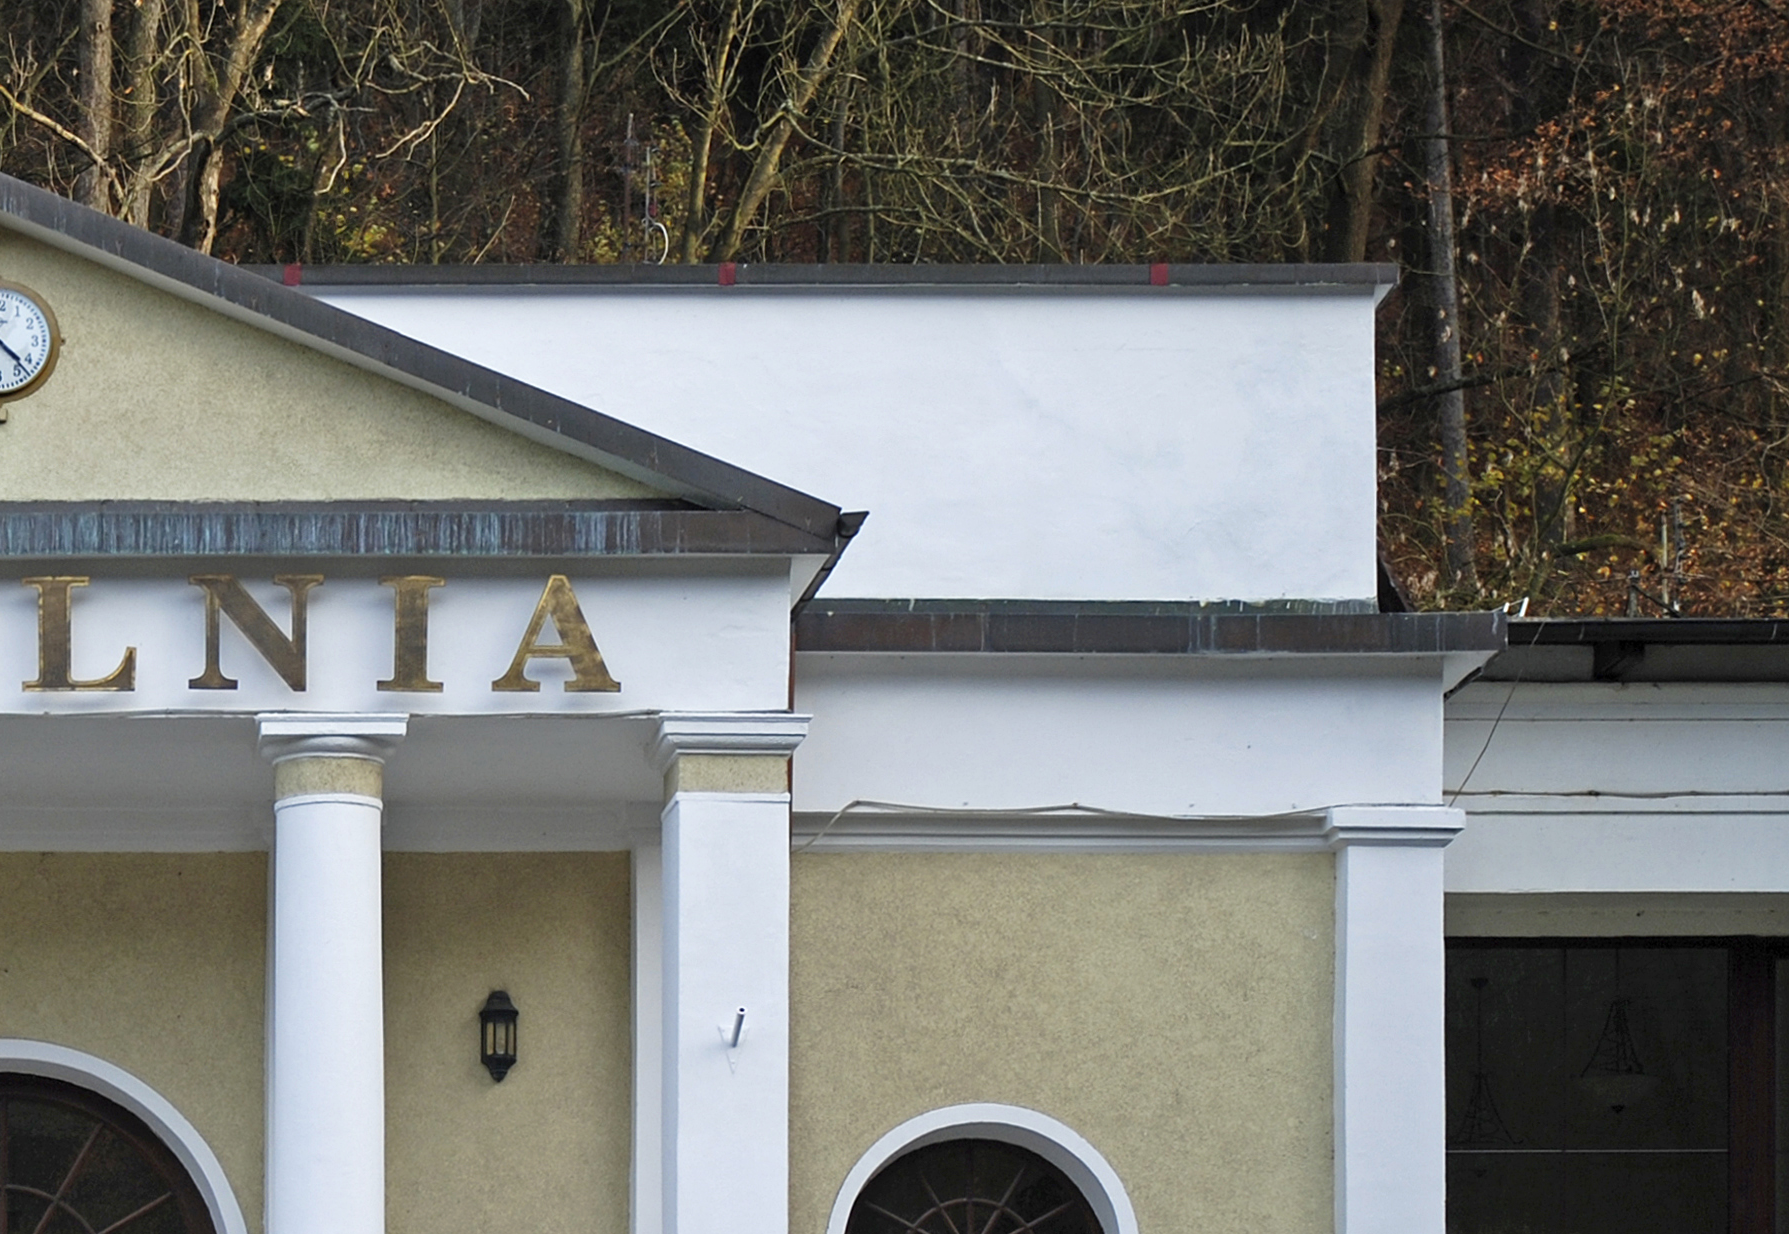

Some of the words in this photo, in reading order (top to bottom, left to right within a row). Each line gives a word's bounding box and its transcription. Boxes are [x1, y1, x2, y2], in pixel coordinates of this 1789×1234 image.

[14, 306, 20, 317] 1
[25, 318, 34, 330] 2
[31, 335, 39, 347] 3
[24, 353, 33, 364] 4
[13, 364, 22, 377] 5
